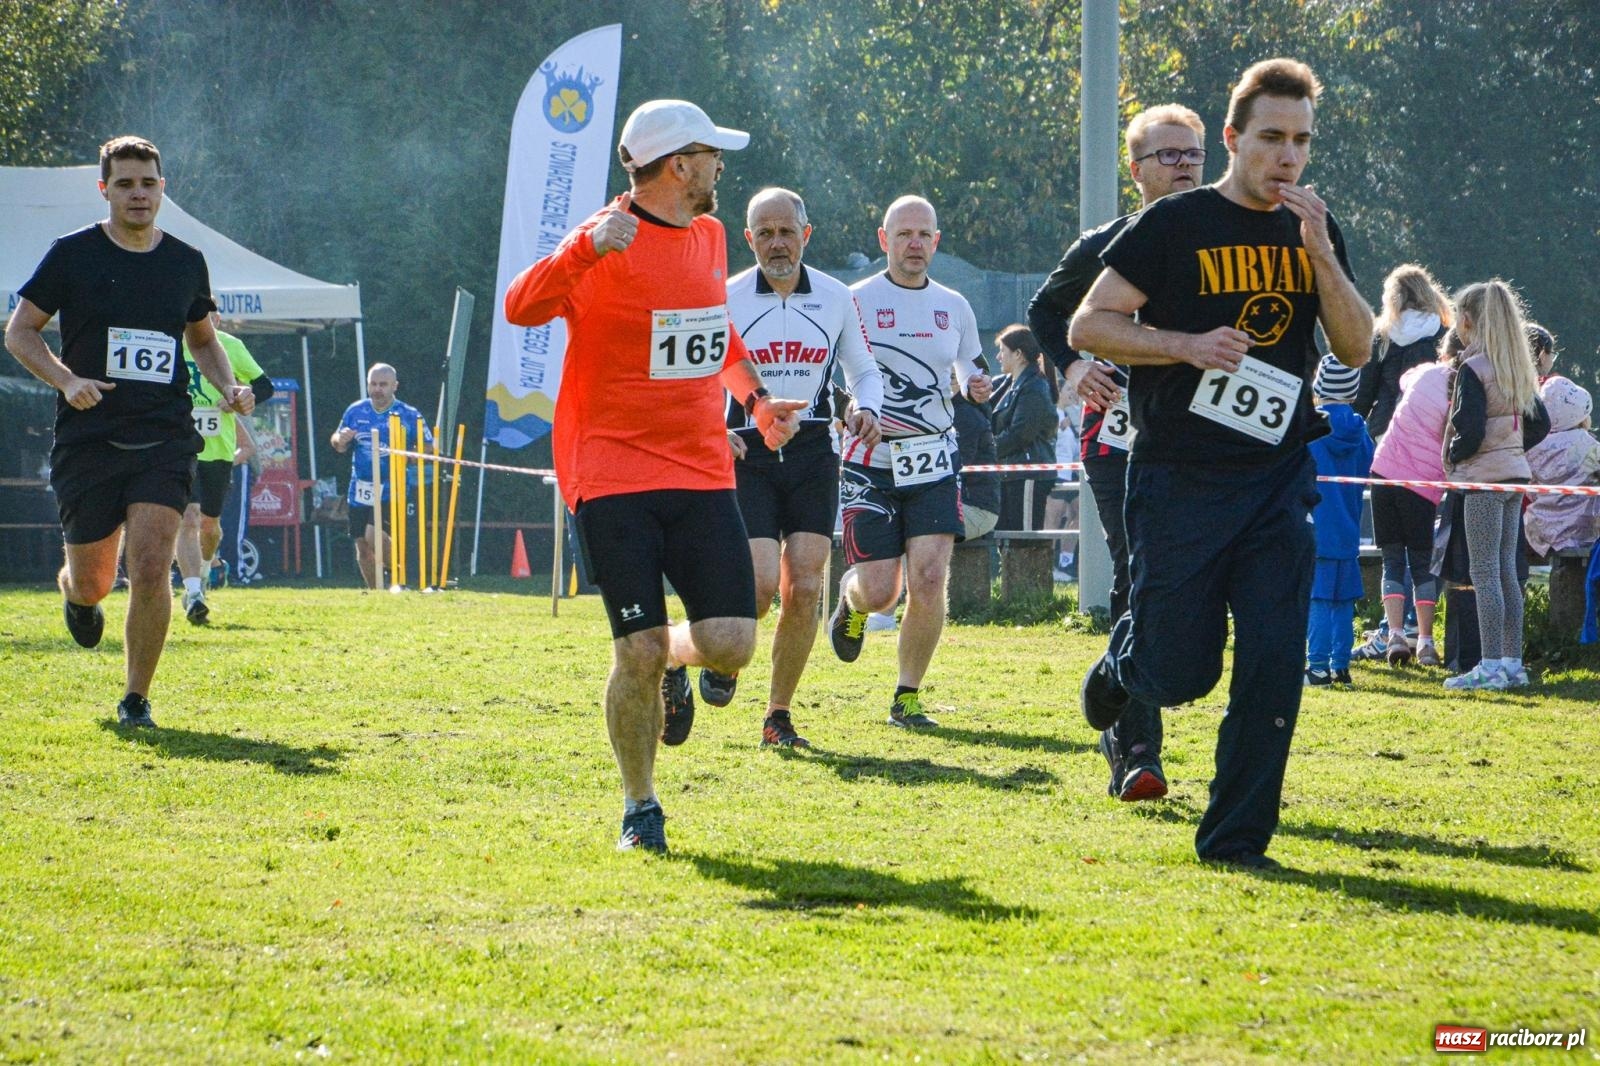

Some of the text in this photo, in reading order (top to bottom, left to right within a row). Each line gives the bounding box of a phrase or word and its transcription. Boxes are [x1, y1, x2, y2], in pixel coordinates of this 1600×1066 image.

[540, 140, 578, 231] STOWARZYSZENIE
[1195, 245, 1314, 295] NIRVAN
[218, 294, 263, 315] JUTRA
[113, 346, 171, 374] 162
[658, 331, 726, 366] 165
[520, 356, 546, 389] JUTRA
[793, 369, 810, 377] PBG
[1208, 375, 1287, 429] 193
[896, 449, 949, 477] 324
[357, 488, 375, 501] 15
